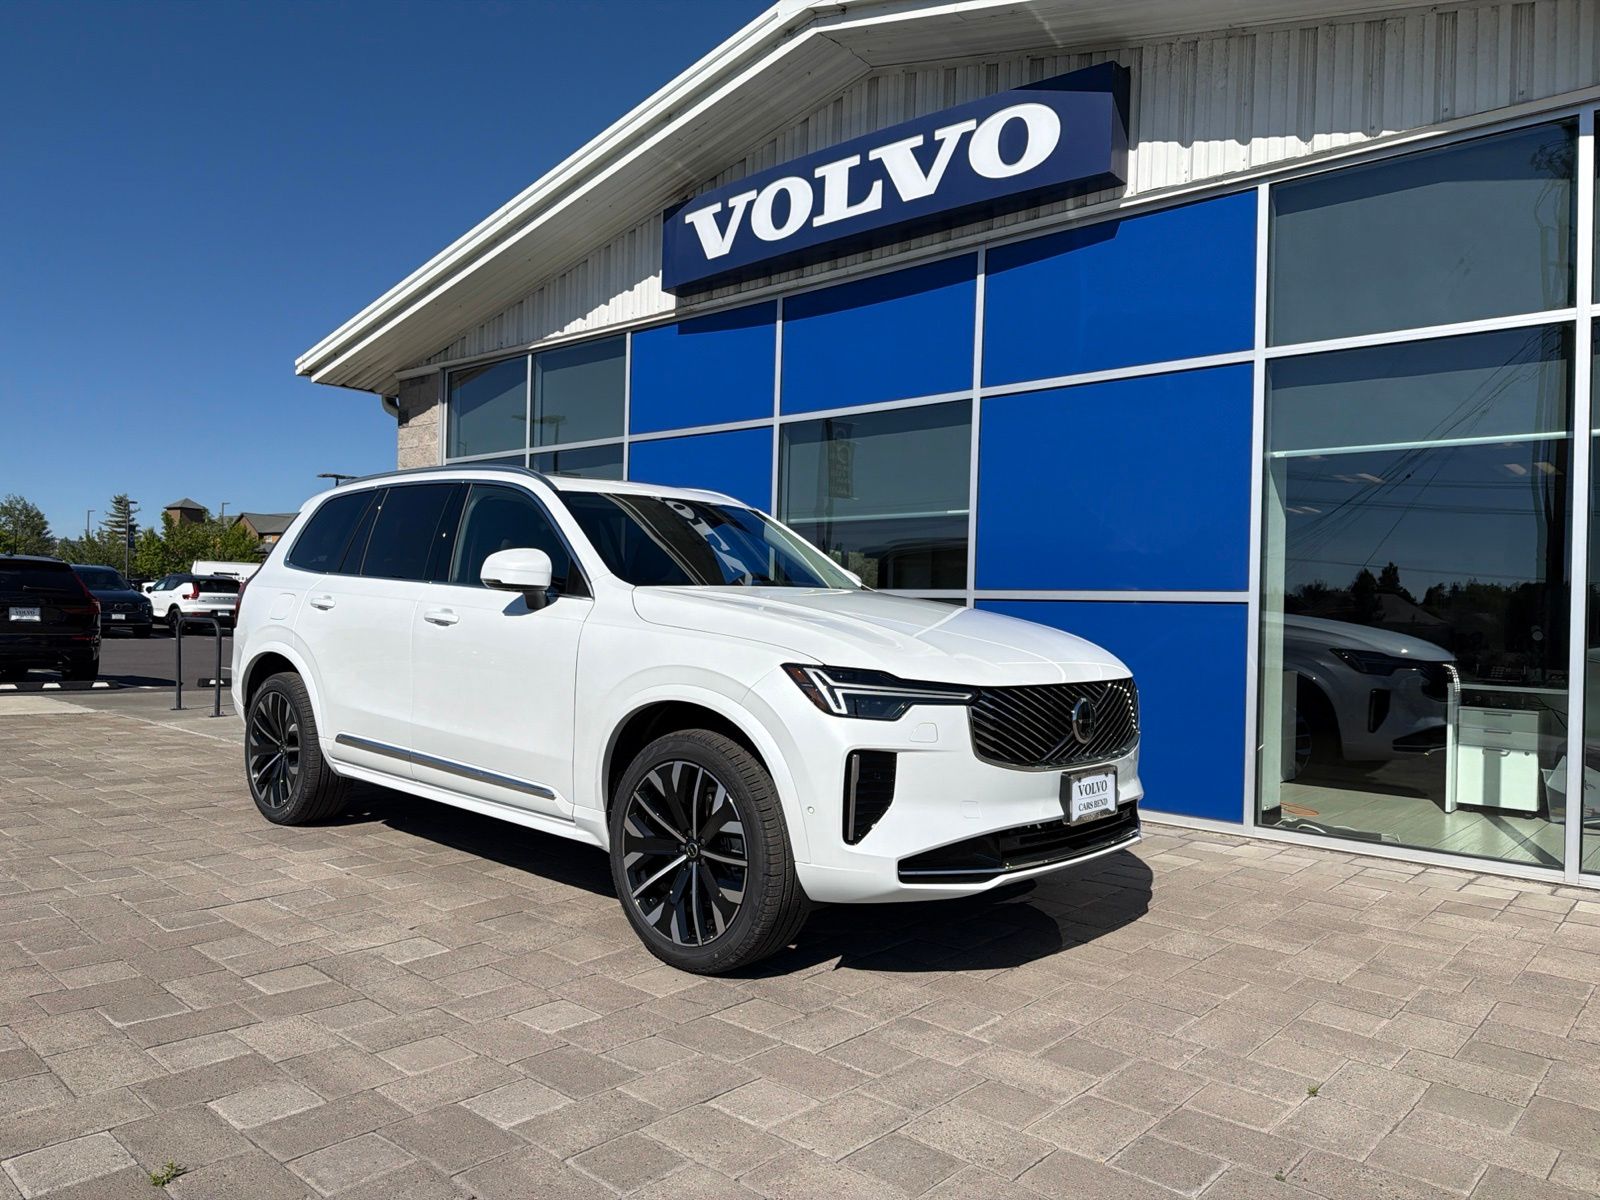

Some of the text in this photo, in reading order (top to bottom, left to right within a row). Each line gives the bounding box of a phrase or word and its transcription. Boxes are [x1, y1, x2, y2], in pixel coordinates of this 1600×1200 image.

[685, 102, 1061, 260] VOLVO
[1078, 780, 1108, 797] VOLVO
[1078, 798, 1108, 812] CARS BEND
